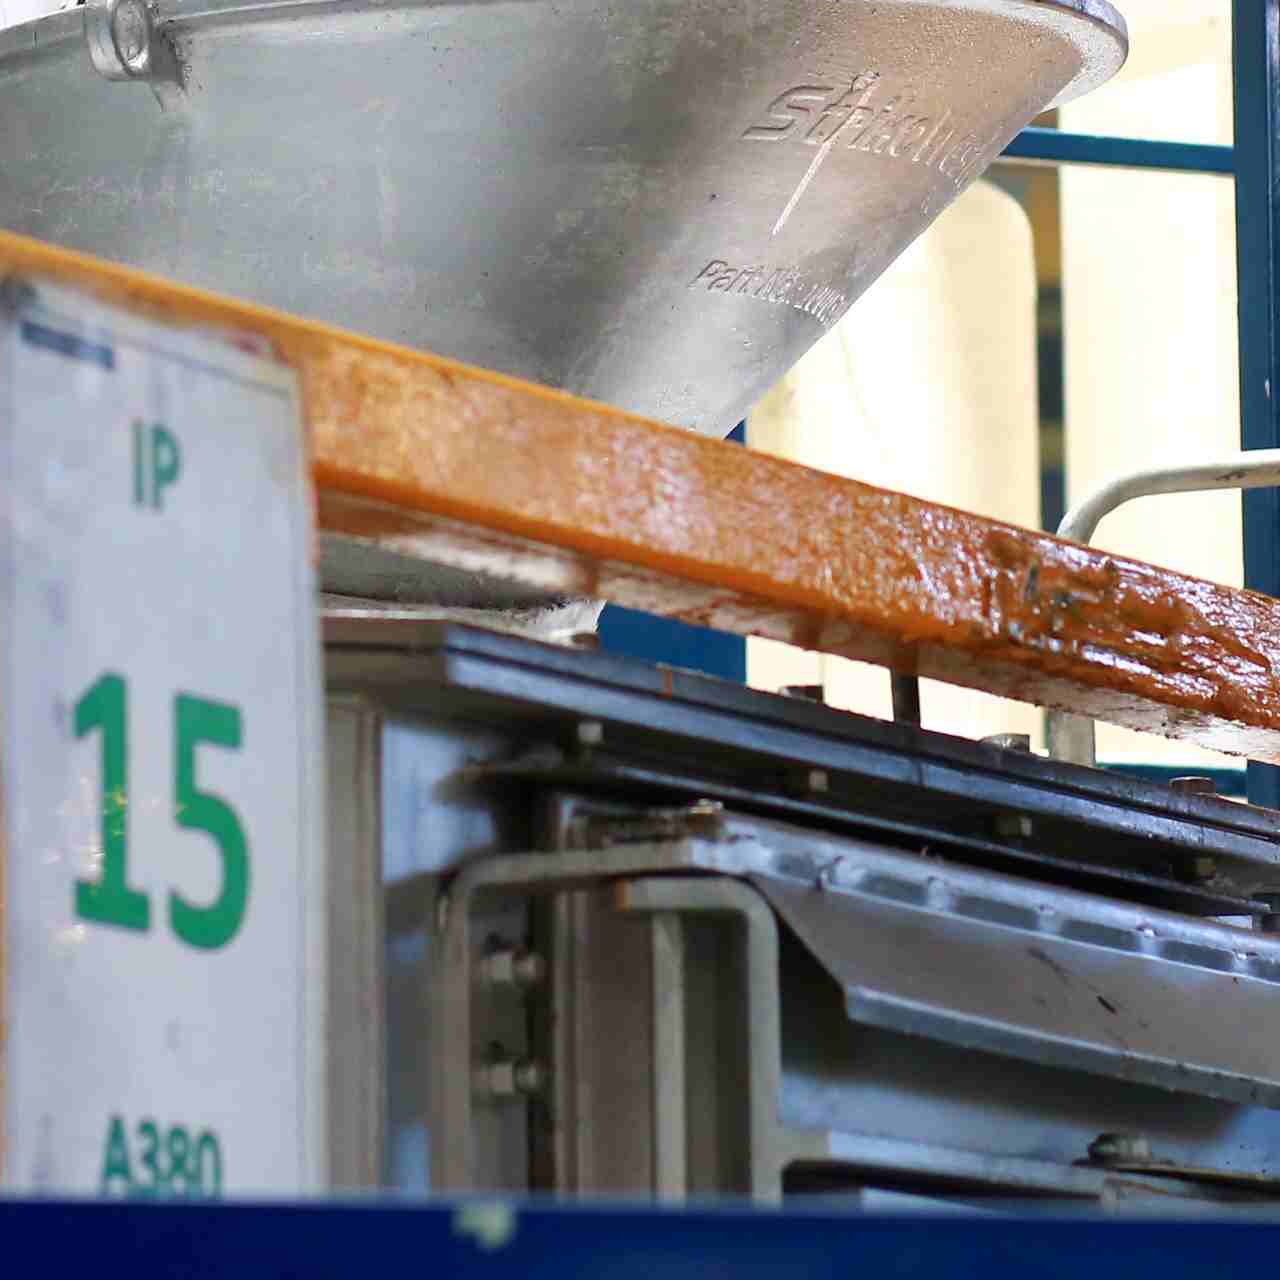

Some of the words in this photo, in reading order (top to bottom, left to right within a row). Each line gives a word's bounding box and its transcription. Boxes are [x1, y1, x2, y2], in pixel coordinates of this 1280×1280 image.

[132, 419, 183, 511] IP
[73, 670, 251, 952] 15
[100, 1116, 223, 1199] A380
